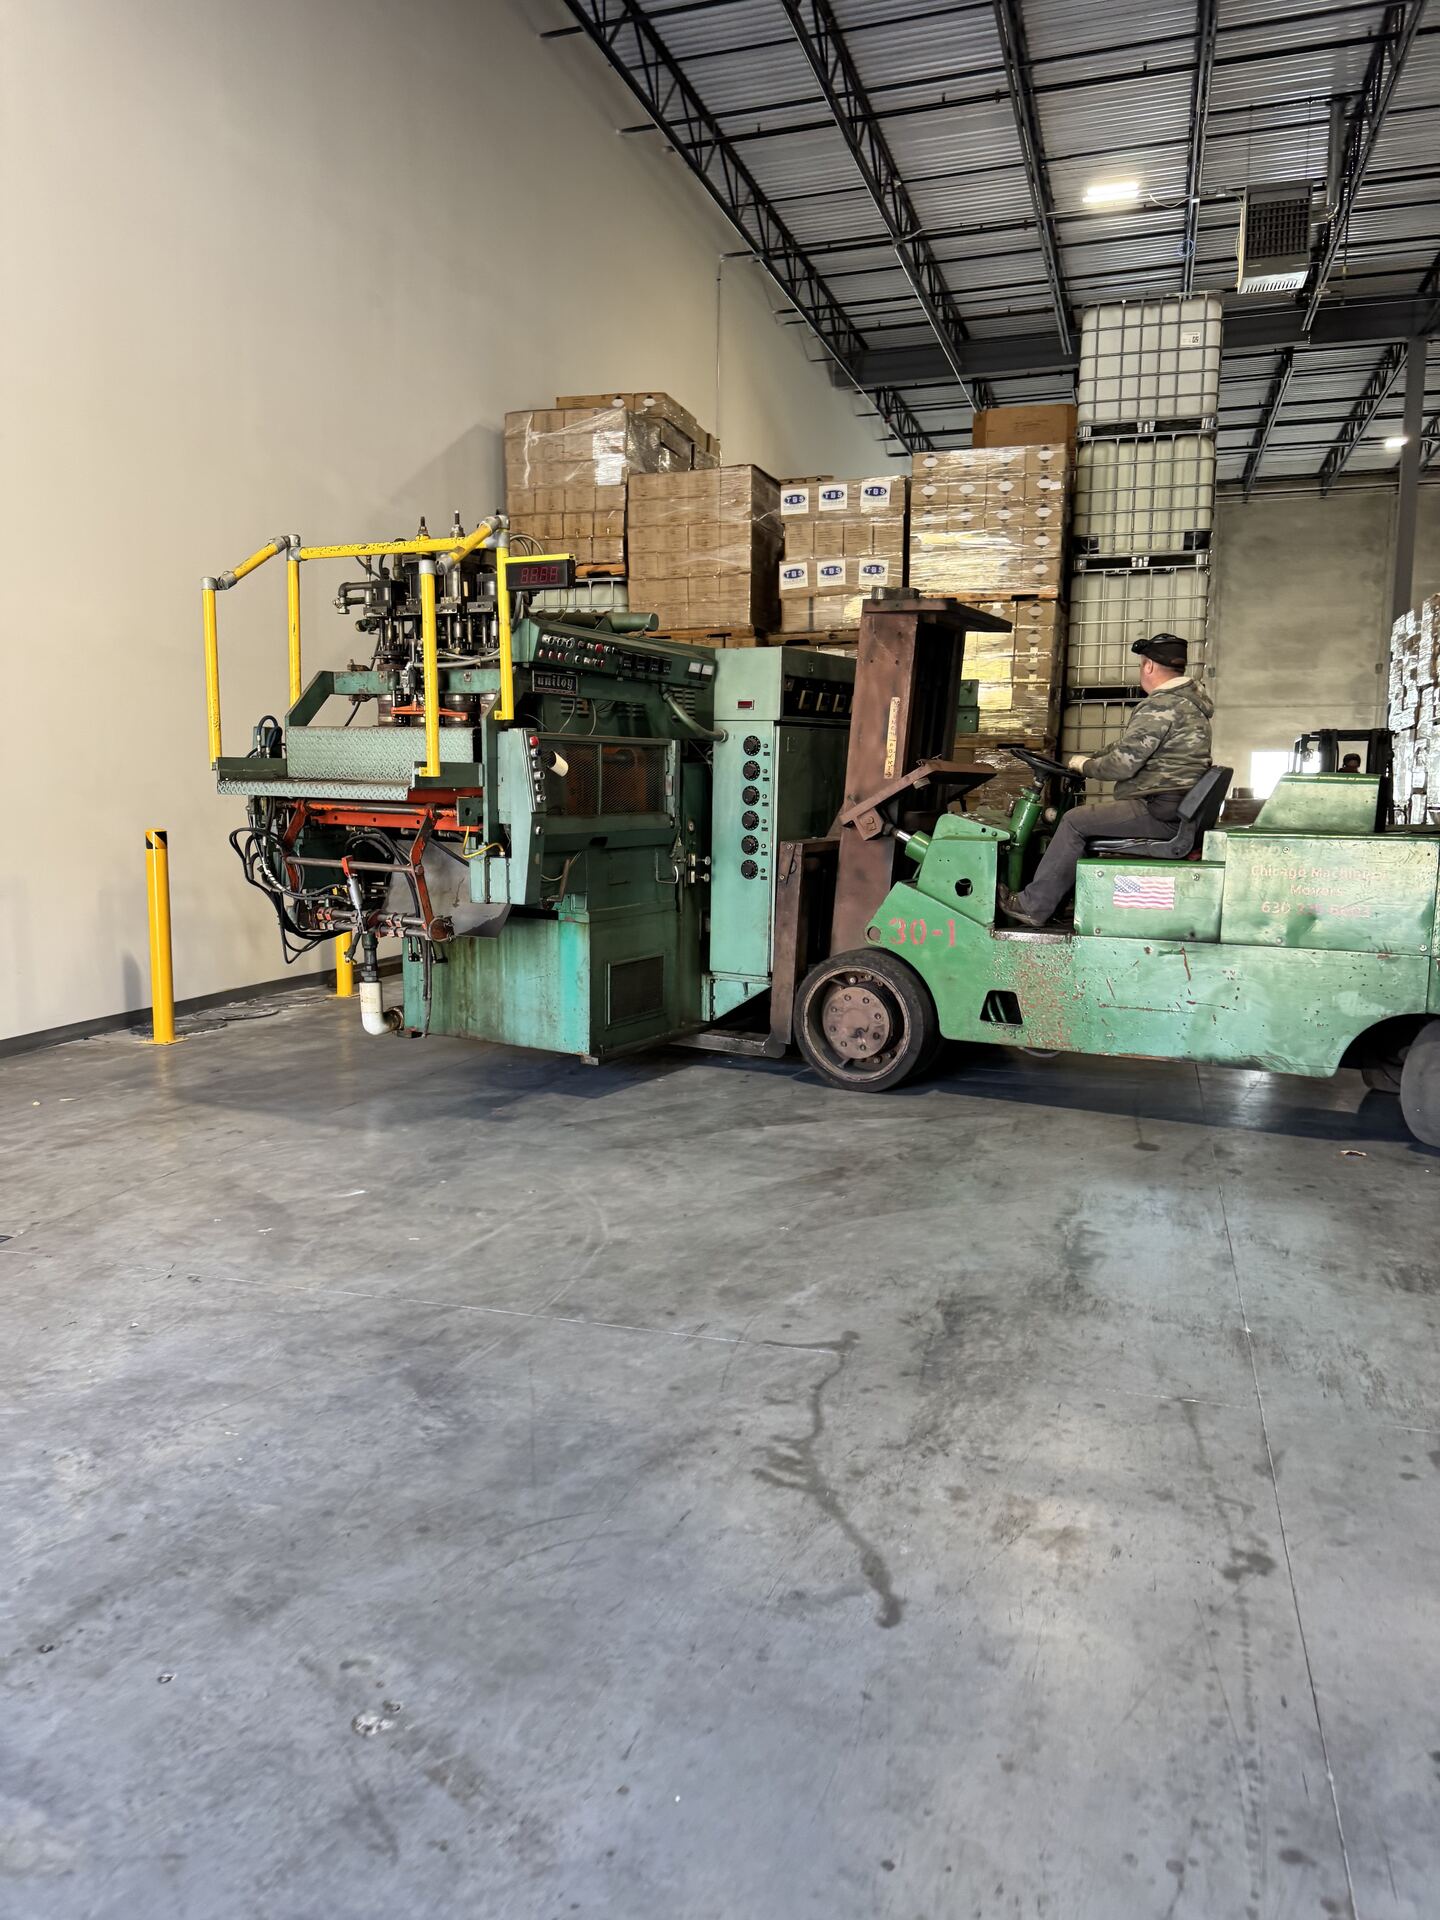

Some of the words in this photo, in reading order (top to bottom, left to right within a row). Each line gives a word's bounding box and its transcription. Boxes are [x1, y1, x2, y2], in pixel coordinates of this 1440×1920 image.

[824, 490, 843, 499] TBS
[866, 487, 886, 495] TBS
[786, 496, 805, 504] TBS
[785, 569, 804, 578] TBS
[822, 566, 841, 575] TBS
[865, 565, 884, 574] TBS
[537, 674, 574, 690] uniloy
[1251, 864, 1306, 880] Chicago
[1290, 884, 1344, 897] Movers
[889, 917, 955, 947] 30-1
